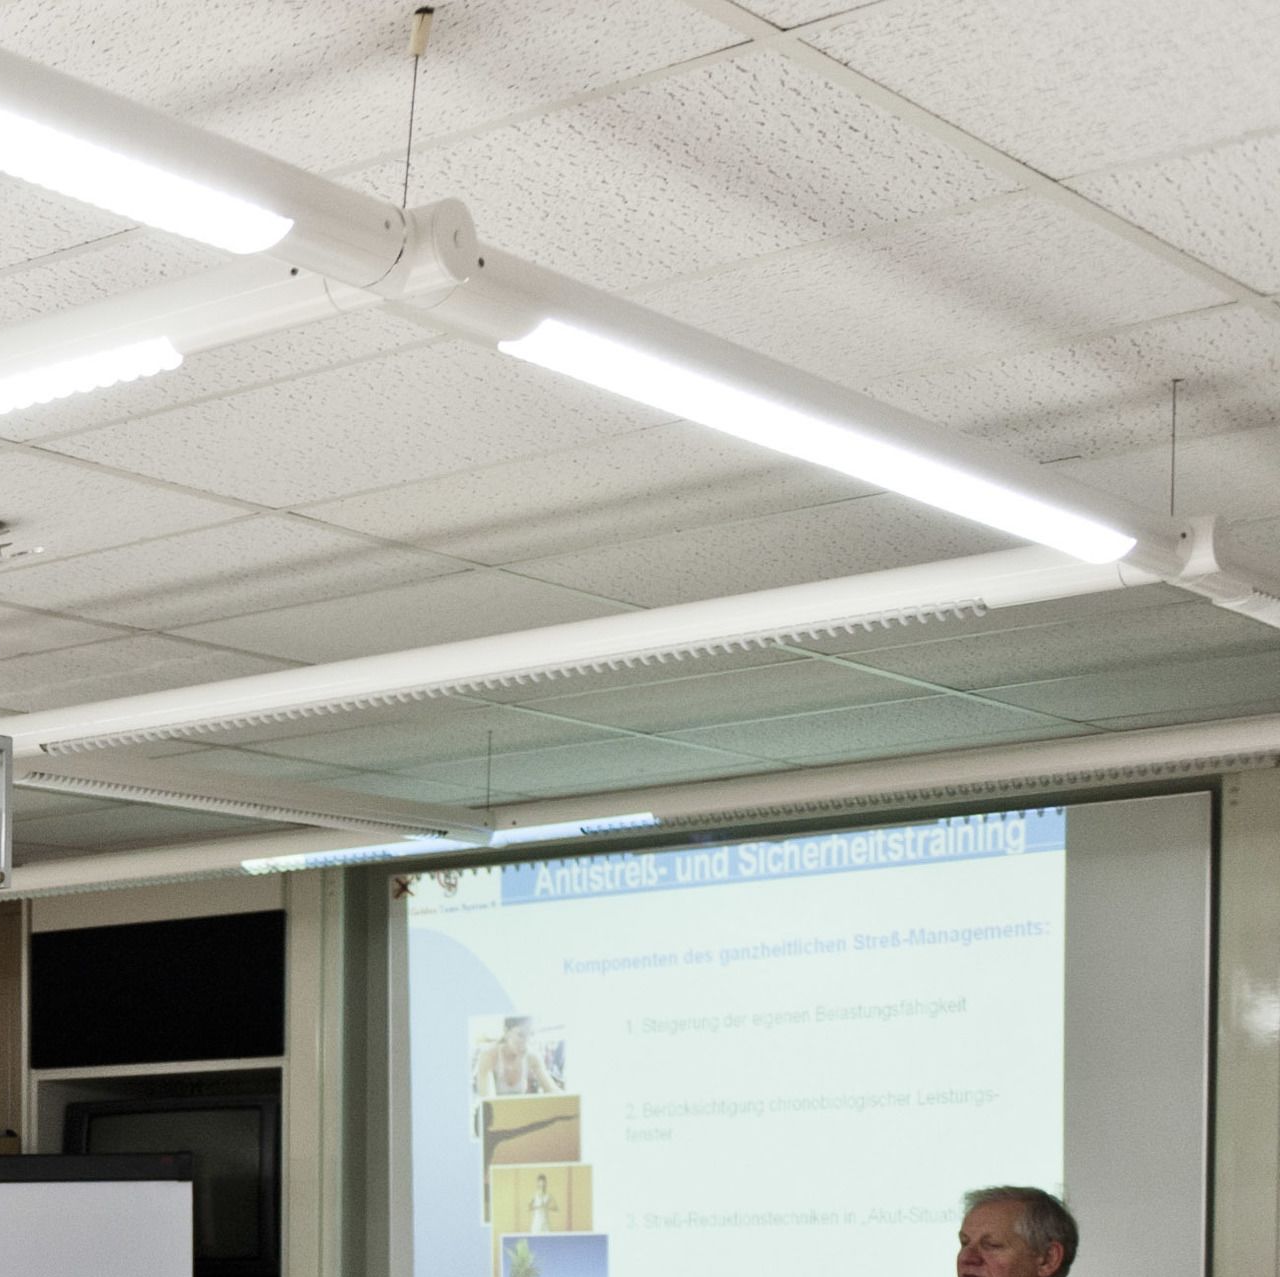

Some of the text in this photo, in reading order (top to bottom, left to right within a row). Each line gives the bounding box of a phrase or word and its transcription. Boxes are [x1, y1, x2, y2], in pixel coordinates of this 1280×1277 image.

[534, 816, 1028, 897] Antistreß- und Sicherheitstraining
[562, 950, 679, 976] Komponenten
[684, 947, 713, 965] des
[641, 1014, 720, 1036] Steigerung
[723, 1013, 748, 1029] der
[751, 1008, 811, 1029] eigenen
[816, 996, 968, 1023] Belastungsfähigkeit
[642, 1098, 766, 1120] Berücksichtigung
[768, 1091, 913, 1116] chronobiologischer
[916, 1086, 1001, 1107] Leistungs-
[843, 1209, 858, 1226] in
